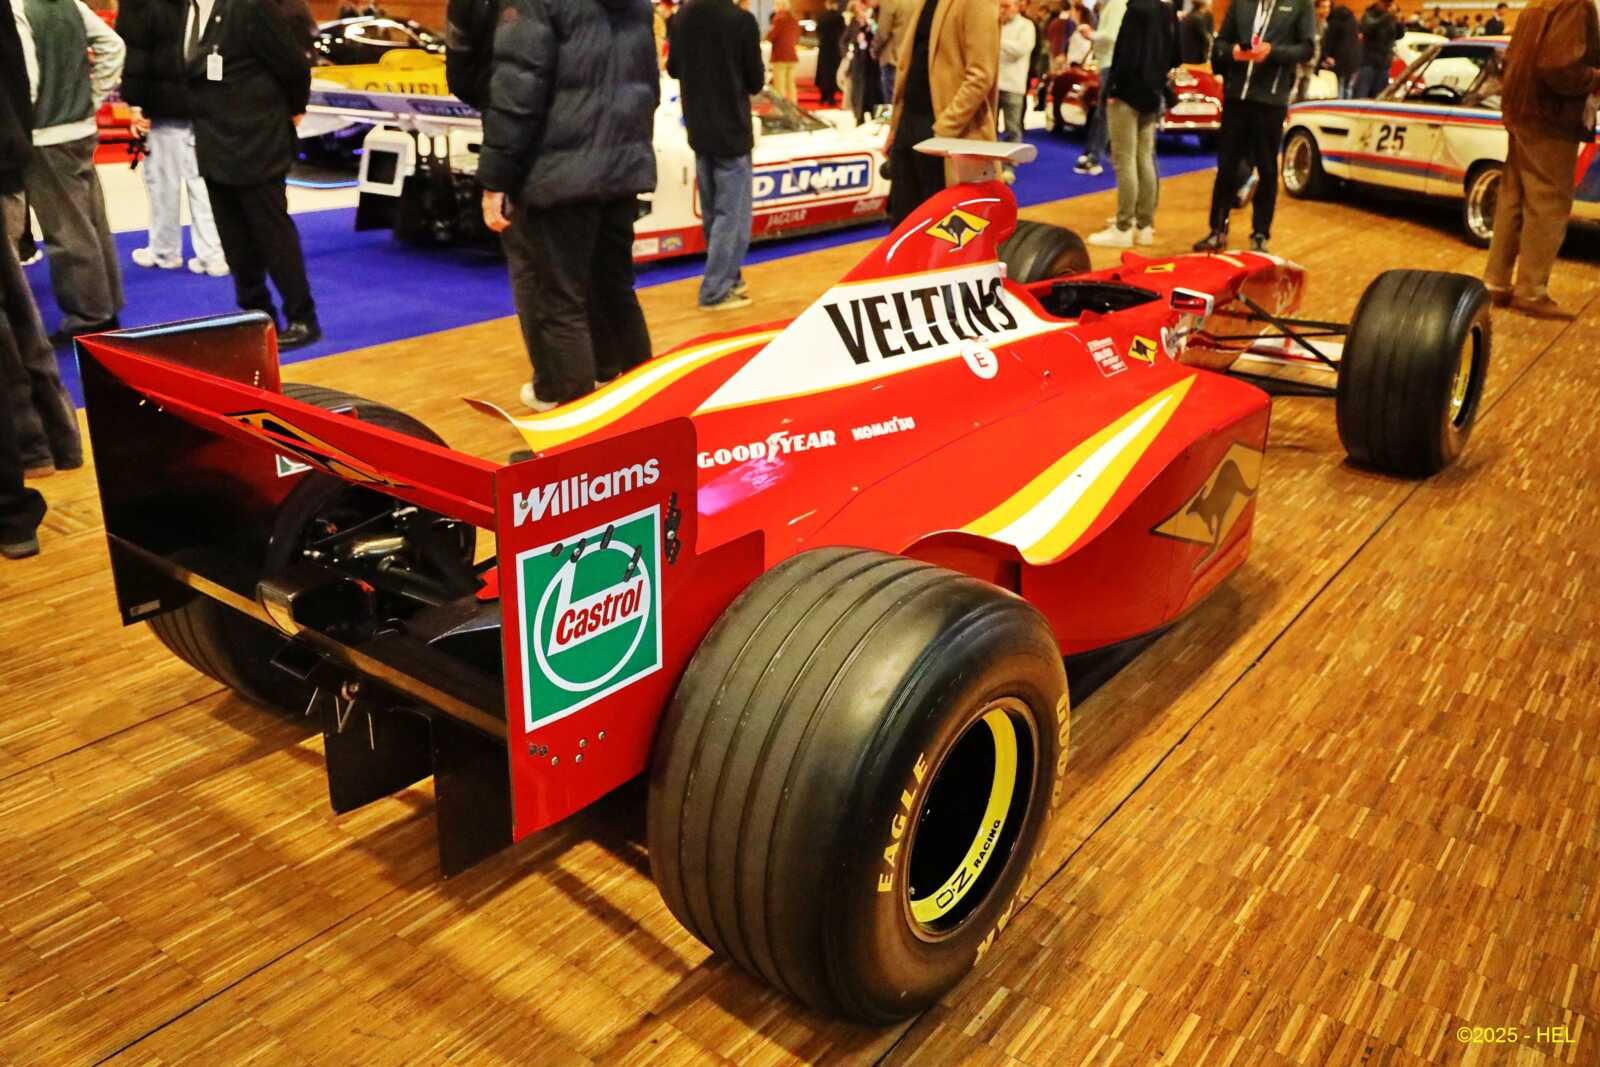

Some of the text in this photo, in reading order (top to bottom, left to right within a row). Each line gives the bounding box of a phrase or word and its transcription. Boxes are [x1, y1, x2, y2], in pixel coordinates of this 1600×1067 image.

[1376, 124, 1407, 152] 25
[823, 277, 1018, 365] VELTINS
[697, 430, 836, 469] GOODYEAR
[851, 416, 915, 441] KOMATSU
[513, 458, 660, 528] Williams
[555, 579, 643, 646] Castrol
[877, 751, 928, 892] EAGLE
[973, 818, 1001, 869] RACING
